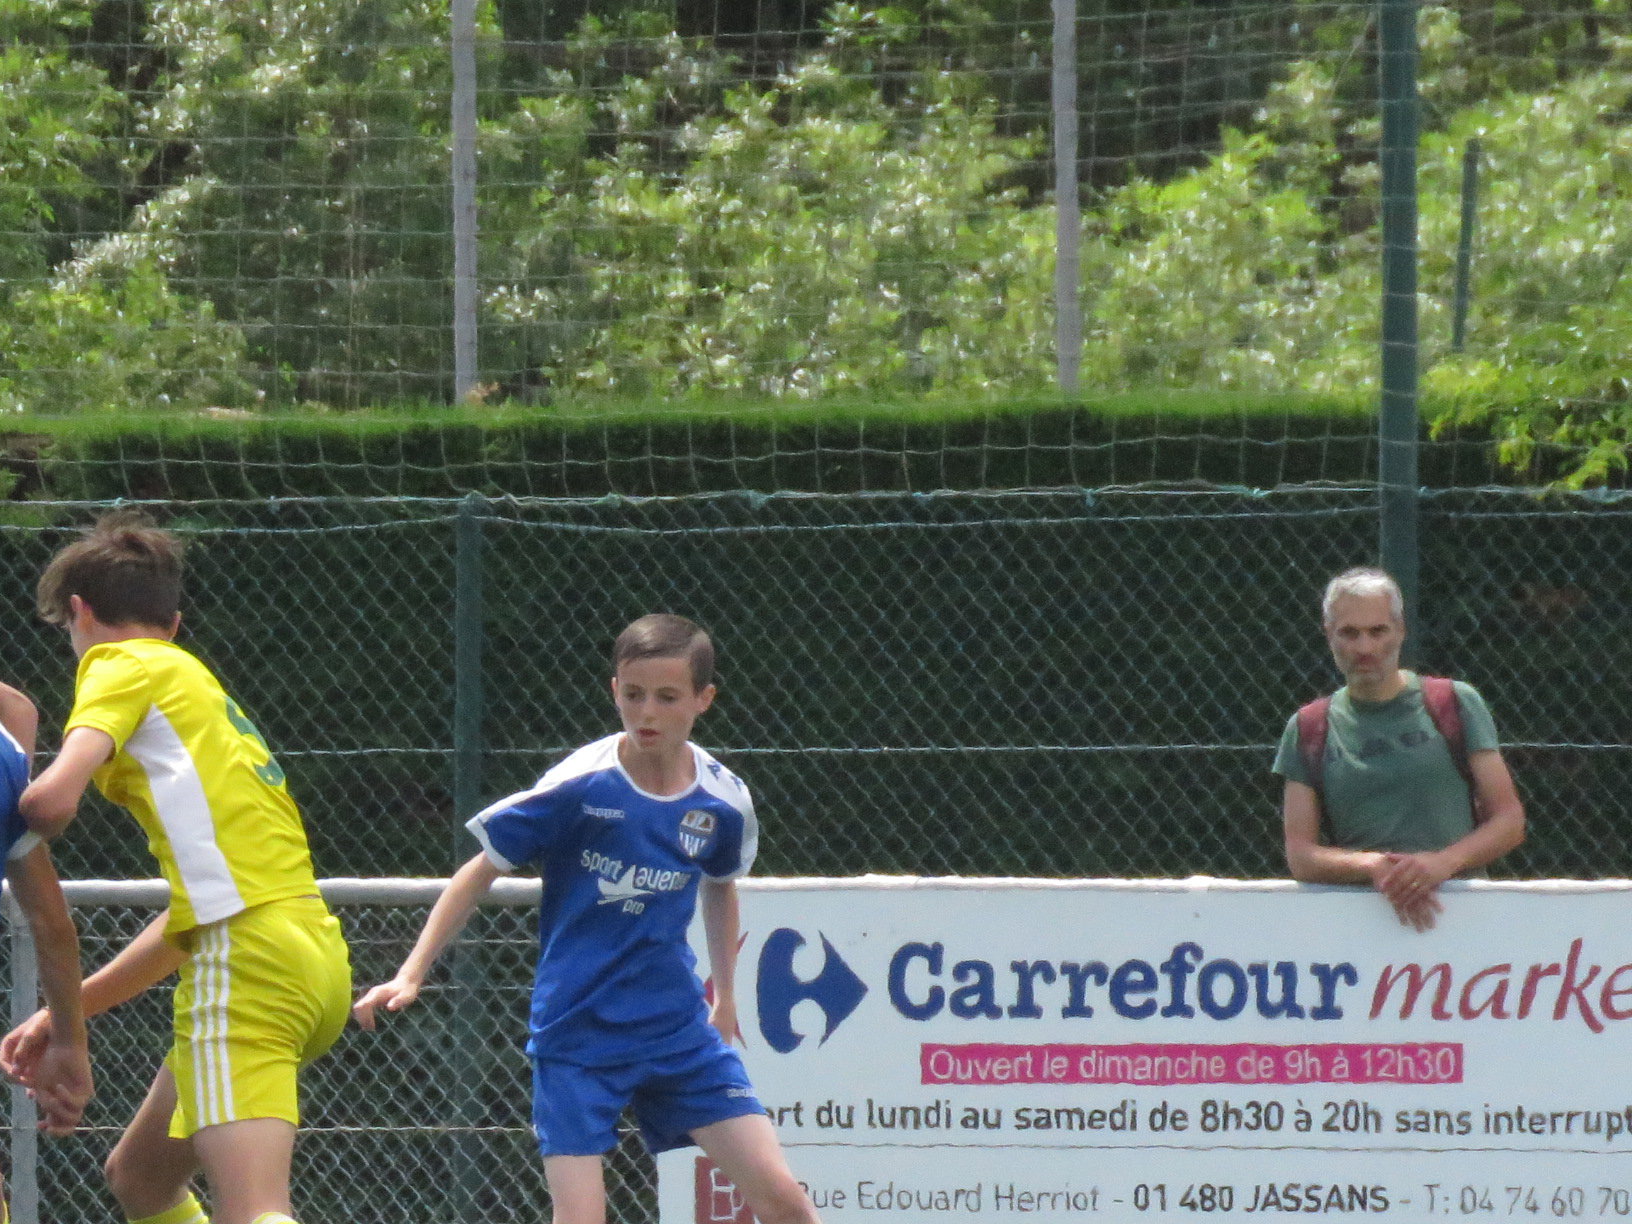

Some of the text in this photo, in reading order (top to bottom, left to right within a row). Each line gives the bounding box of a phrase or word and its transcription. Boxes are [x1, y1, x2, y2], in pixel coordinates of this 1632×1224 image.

[888, 941, 1358, 1021] Carrefour
[929, 1047, 1456, 1080] Ouvert le dimanche de 9h à 12h30
[816, 1100, 854, 1128] du
[867, 1098, 952, 1129] lundi
[960, 1104, 1002, 1129] au
[1014, 1099, 1137, 1131] samedi
[1148, 1100, 1188, 1132] de
[1200, 1099, 1284, 1133] 8h30
[1294, 1098, 1313, 1132] à
[1322, 1100, 1382, 1132] 20h
[1395, 1107, 1471, 1136] sans
[858, 1181, 981, 1211] Edouard
[994, 1182, 1099, 1211] Herriot
[1133, 1183, 1167, 1212] 01
[1179, 1182, 1234, 1212] 480
[1243, 1183, 1390, 1214] JASSANS
[1460, 1185, 1494, 1216] 04
[1505, 1185, 1539, 1216] 74
[1552, 1186, 1585, 1217] 60
[1598, 1187, 1630, 1215] 70
